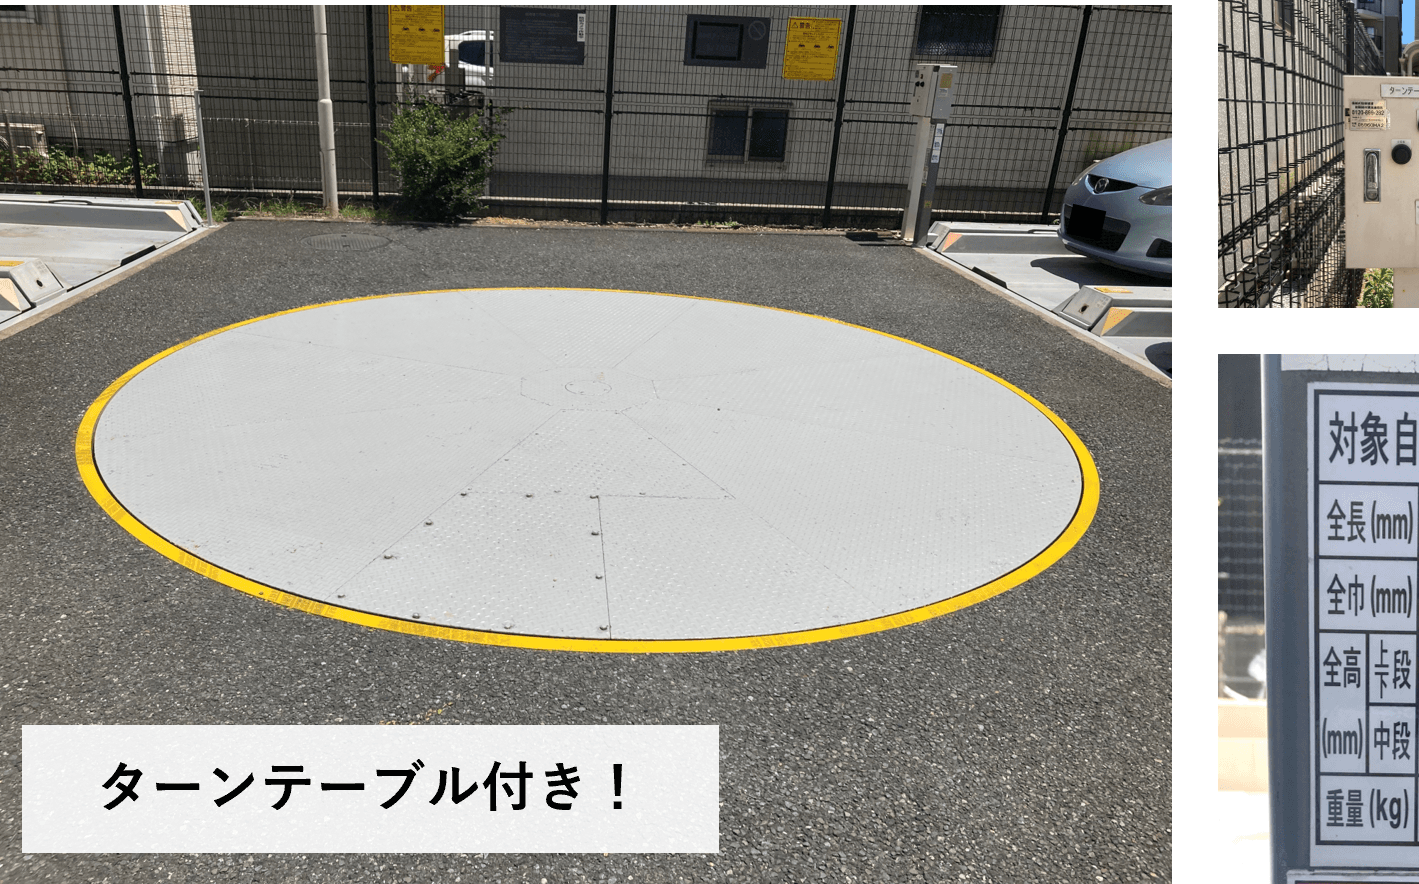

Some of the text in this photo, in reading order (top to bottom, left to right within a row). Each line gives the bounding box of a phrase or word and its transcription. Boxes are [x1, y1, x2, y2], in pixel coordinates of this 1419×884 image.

[1322, 646, 1362, 689] 全高
[1321, 717, 1363, 760] (mm)
[1373, 720, 1411, 761] 中段
